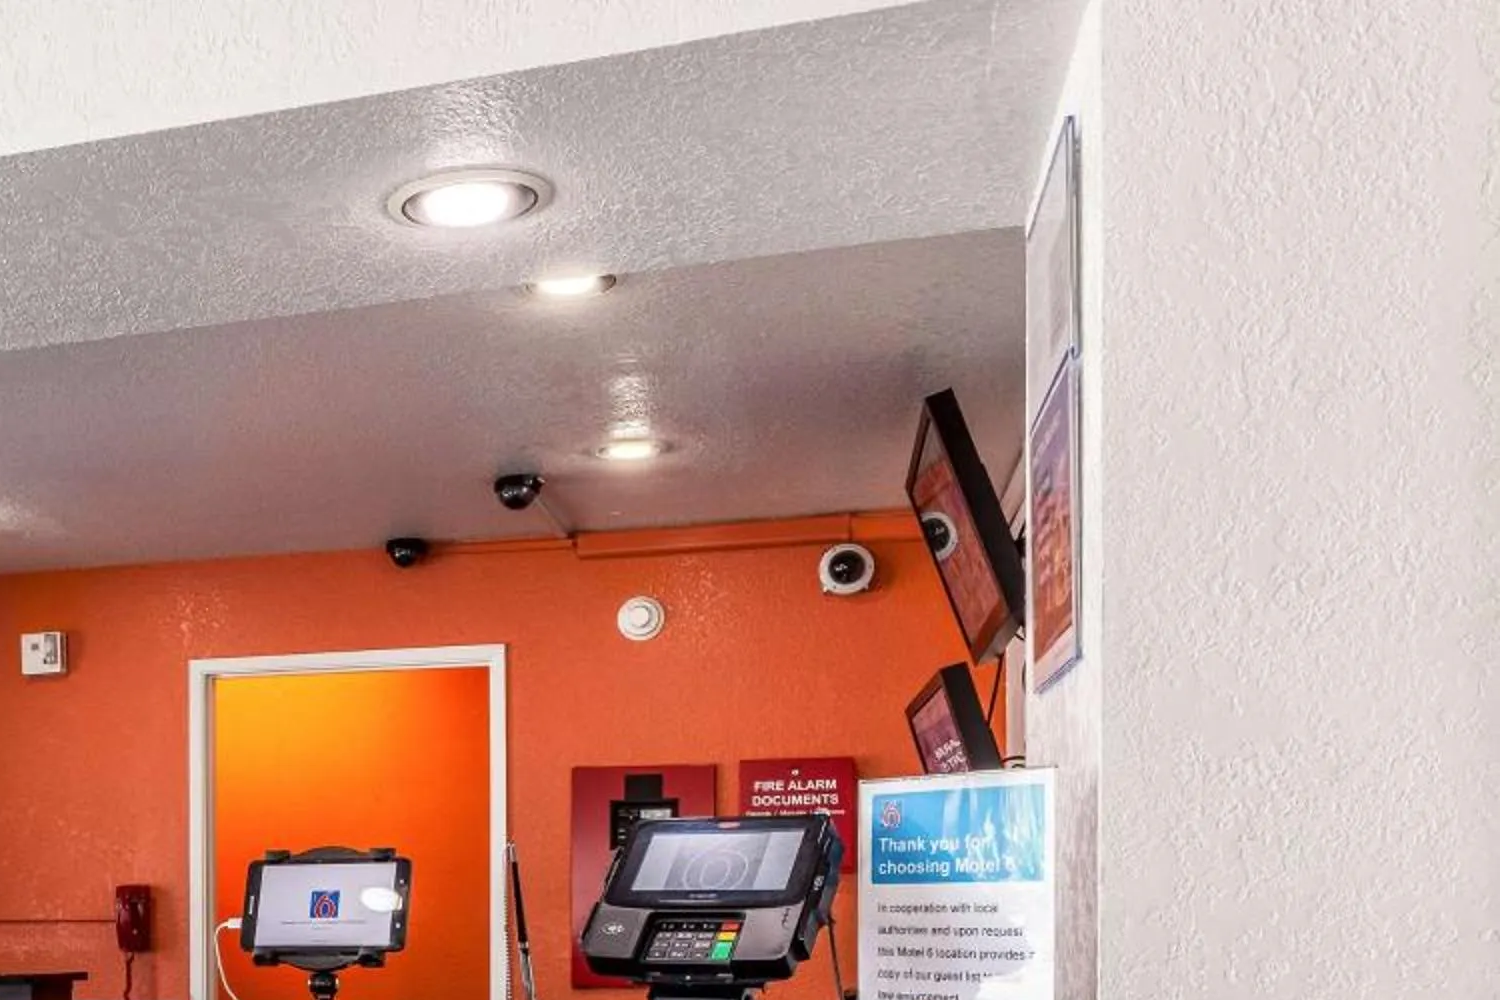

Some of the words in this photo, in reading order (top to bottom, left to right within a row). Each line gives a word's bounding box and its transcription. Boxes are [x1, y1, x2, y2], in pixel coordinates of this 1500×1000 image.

[753, 780, 785, 792] FIRE
[787, 779, 838, 791] ALARM
[751, 793, 839, 807] DOCUMENTS
[878, 835, 926, 852] Thank
[929, 837, 961, 855] you
[878, 859, 950, 877] choosing
[955, 857, 1000, 873] Motel
[889, 903, 948, 916] cooperation
[930, 925, 951, 937] and
[897, 946, 924, 958] Motel
[936, 946, 977, 960] location
[979, 948, 1026, 961] provides
